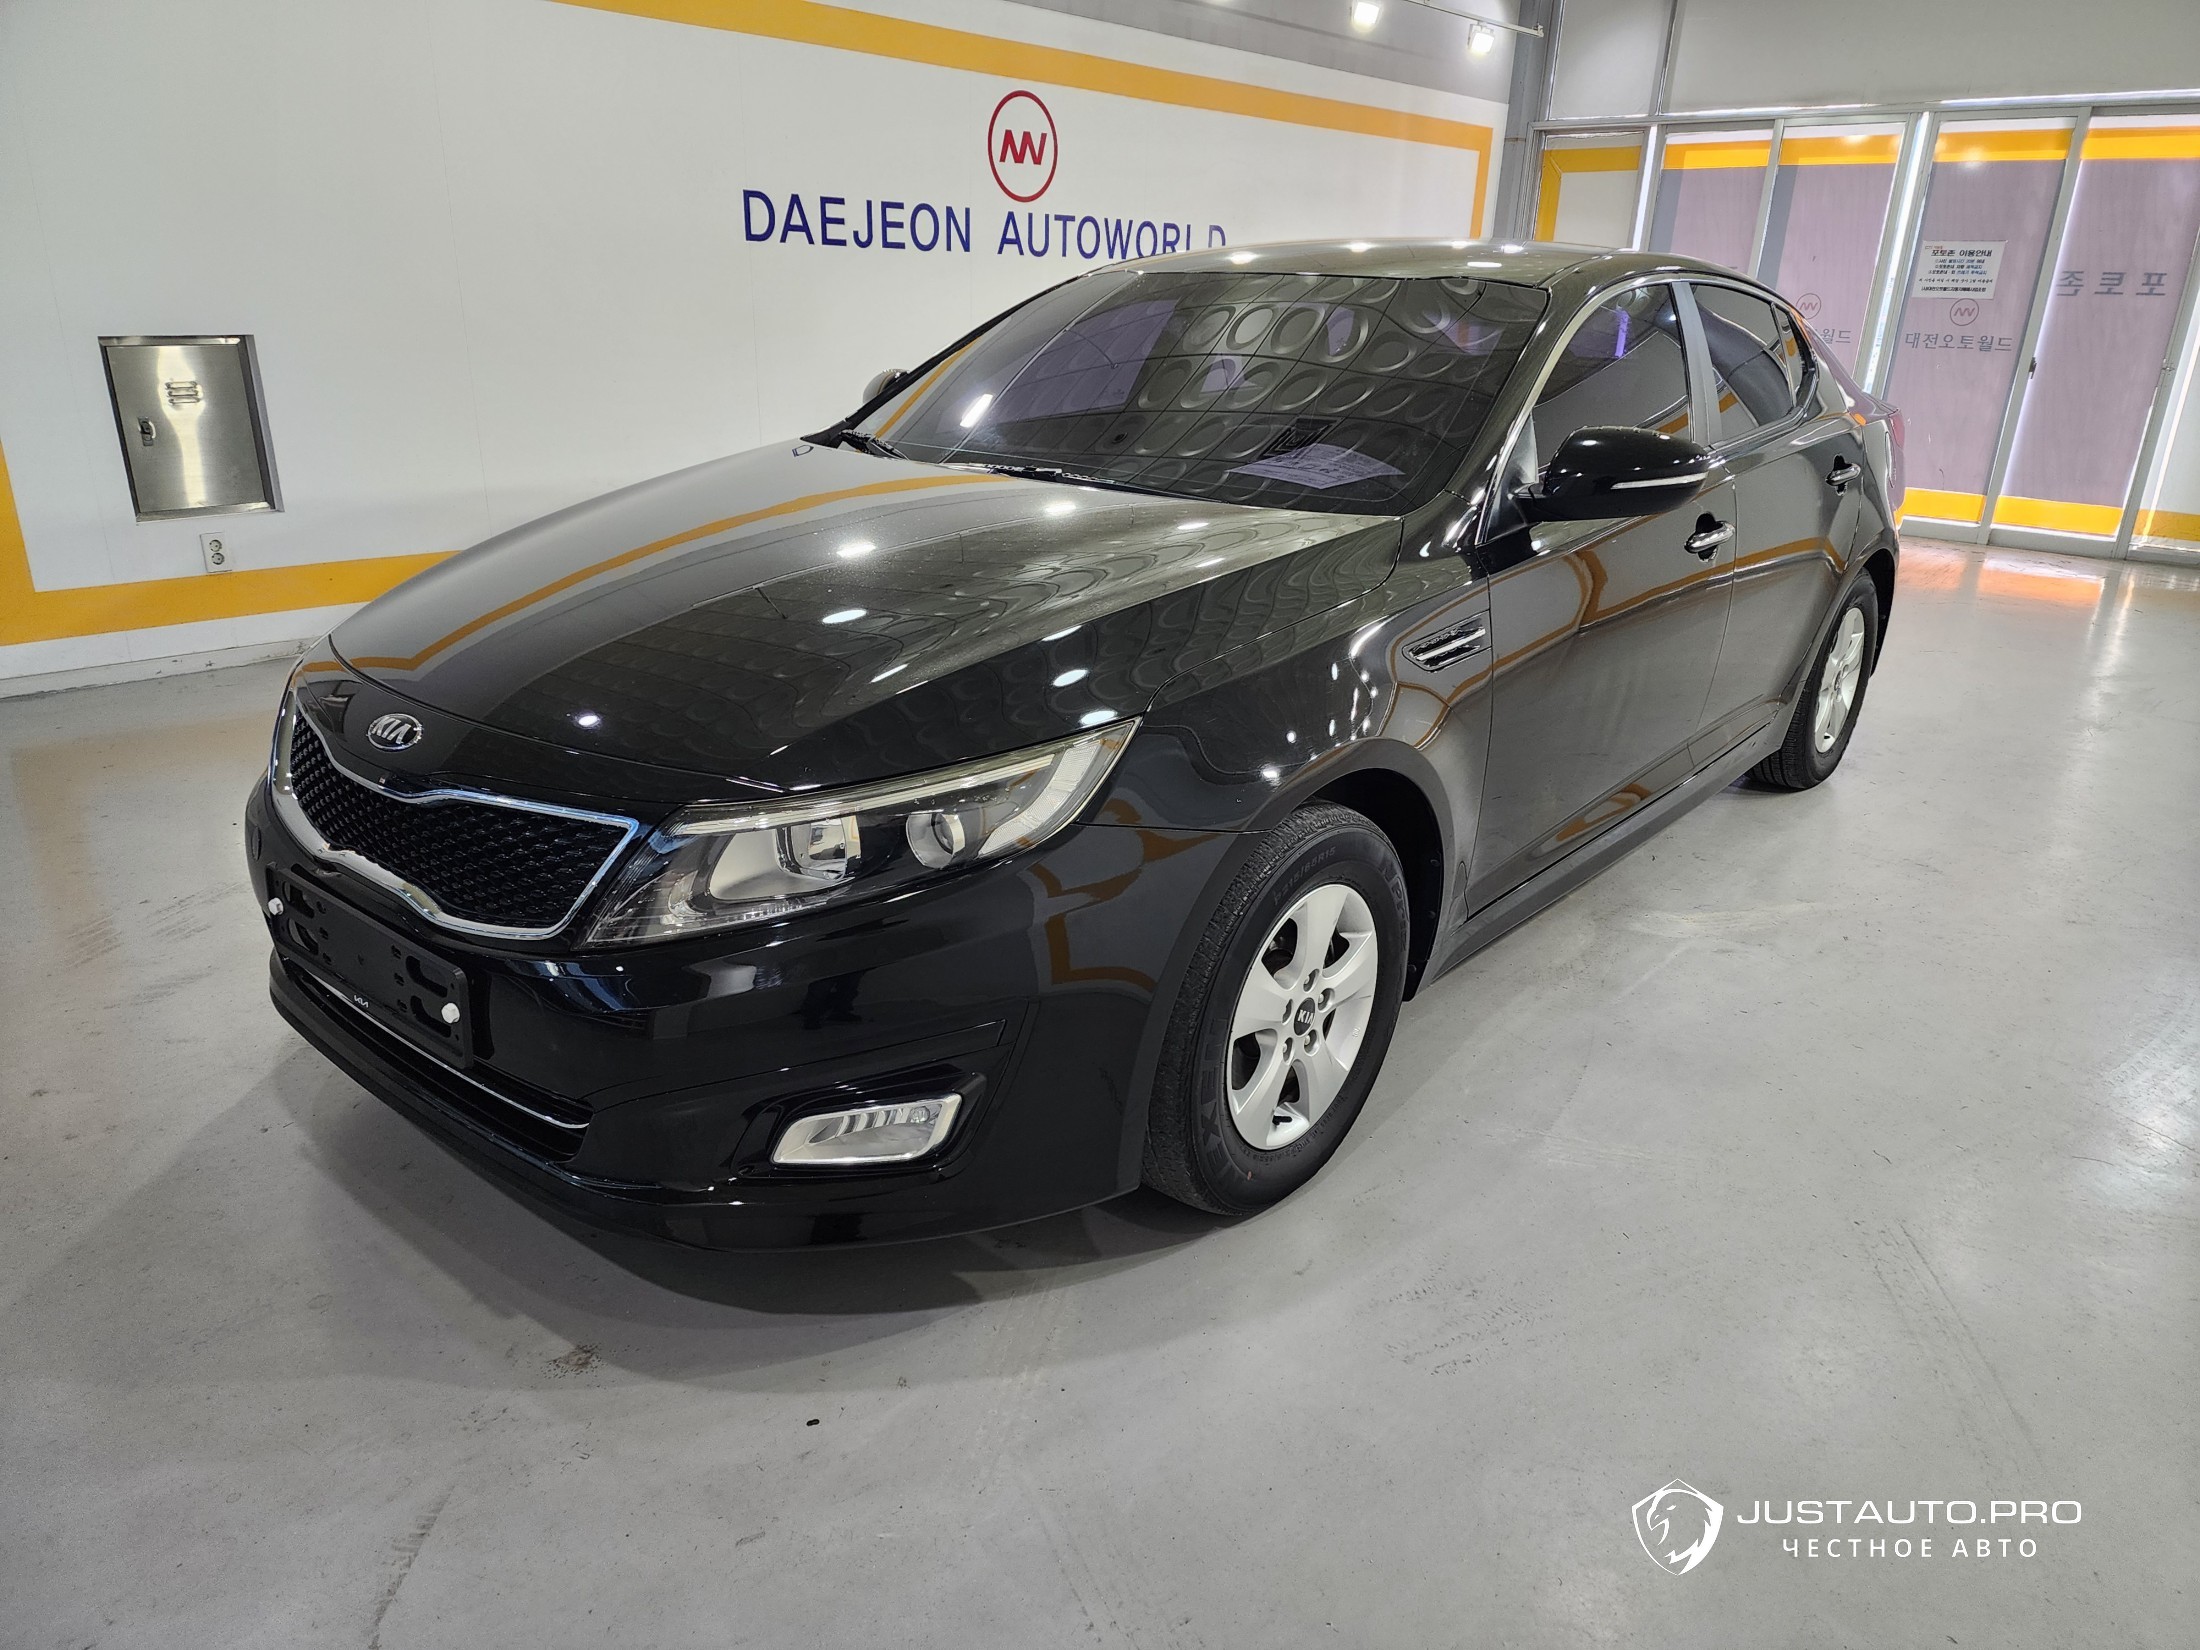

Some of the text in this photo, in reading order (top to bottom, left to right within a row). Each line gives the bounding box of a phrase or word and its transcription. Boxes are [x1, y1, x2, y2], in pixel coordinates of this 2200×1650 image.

[743, 189, 972, 253] DAEJEON
[1904, 332, 2013, 352] 대전오토월드
[371, 716, 412, 745] KIA
